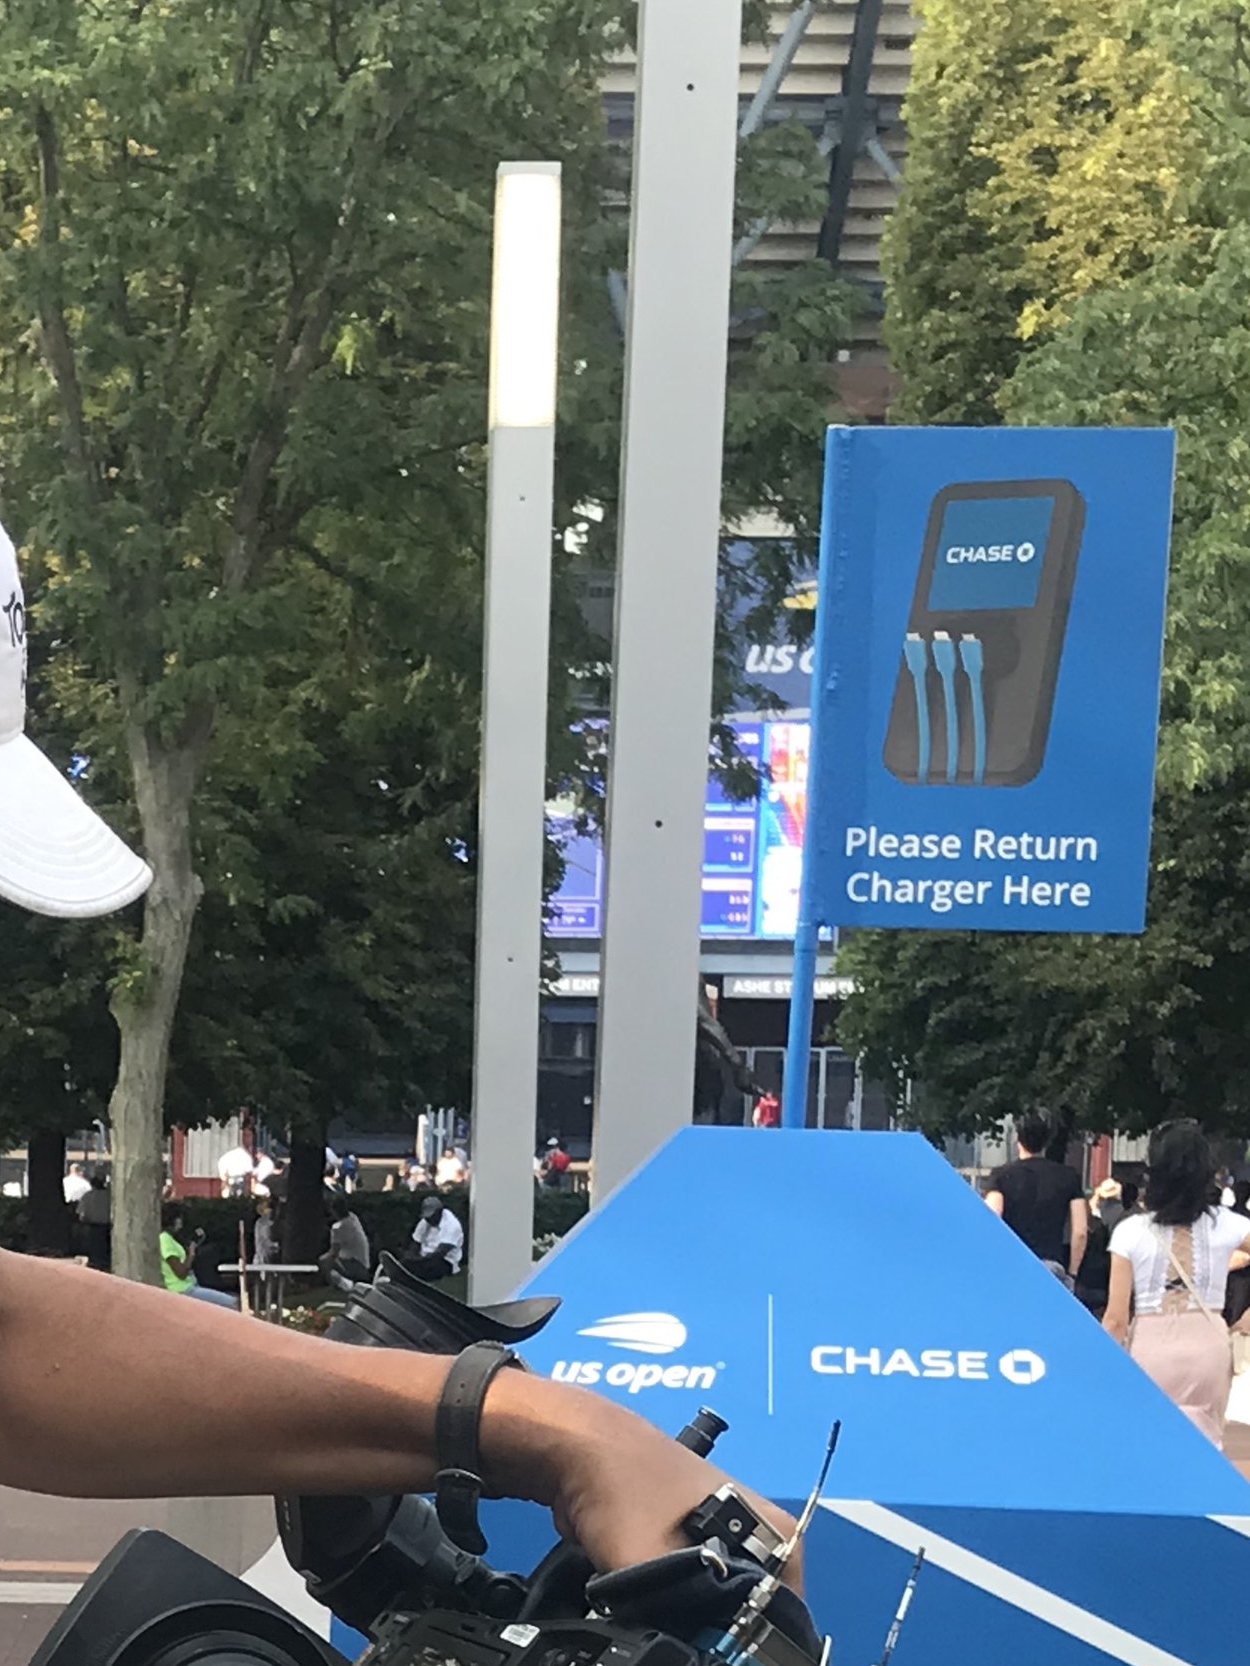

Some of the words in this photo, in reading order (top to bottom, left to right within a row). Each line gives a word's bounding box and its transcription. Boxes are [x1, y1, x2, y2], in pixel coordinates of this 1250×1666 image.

[946, 545, 1015, 564] CHASE
[845, 826, 962, 859] Please
[974, 829, 1098, 861] Return
[846, 871, 993, 913] Charger
[1003, 875, 1091, 907] Here
[551, 1360, 604, 1385] us
[811, 1345, 989, 1380] CHASE
